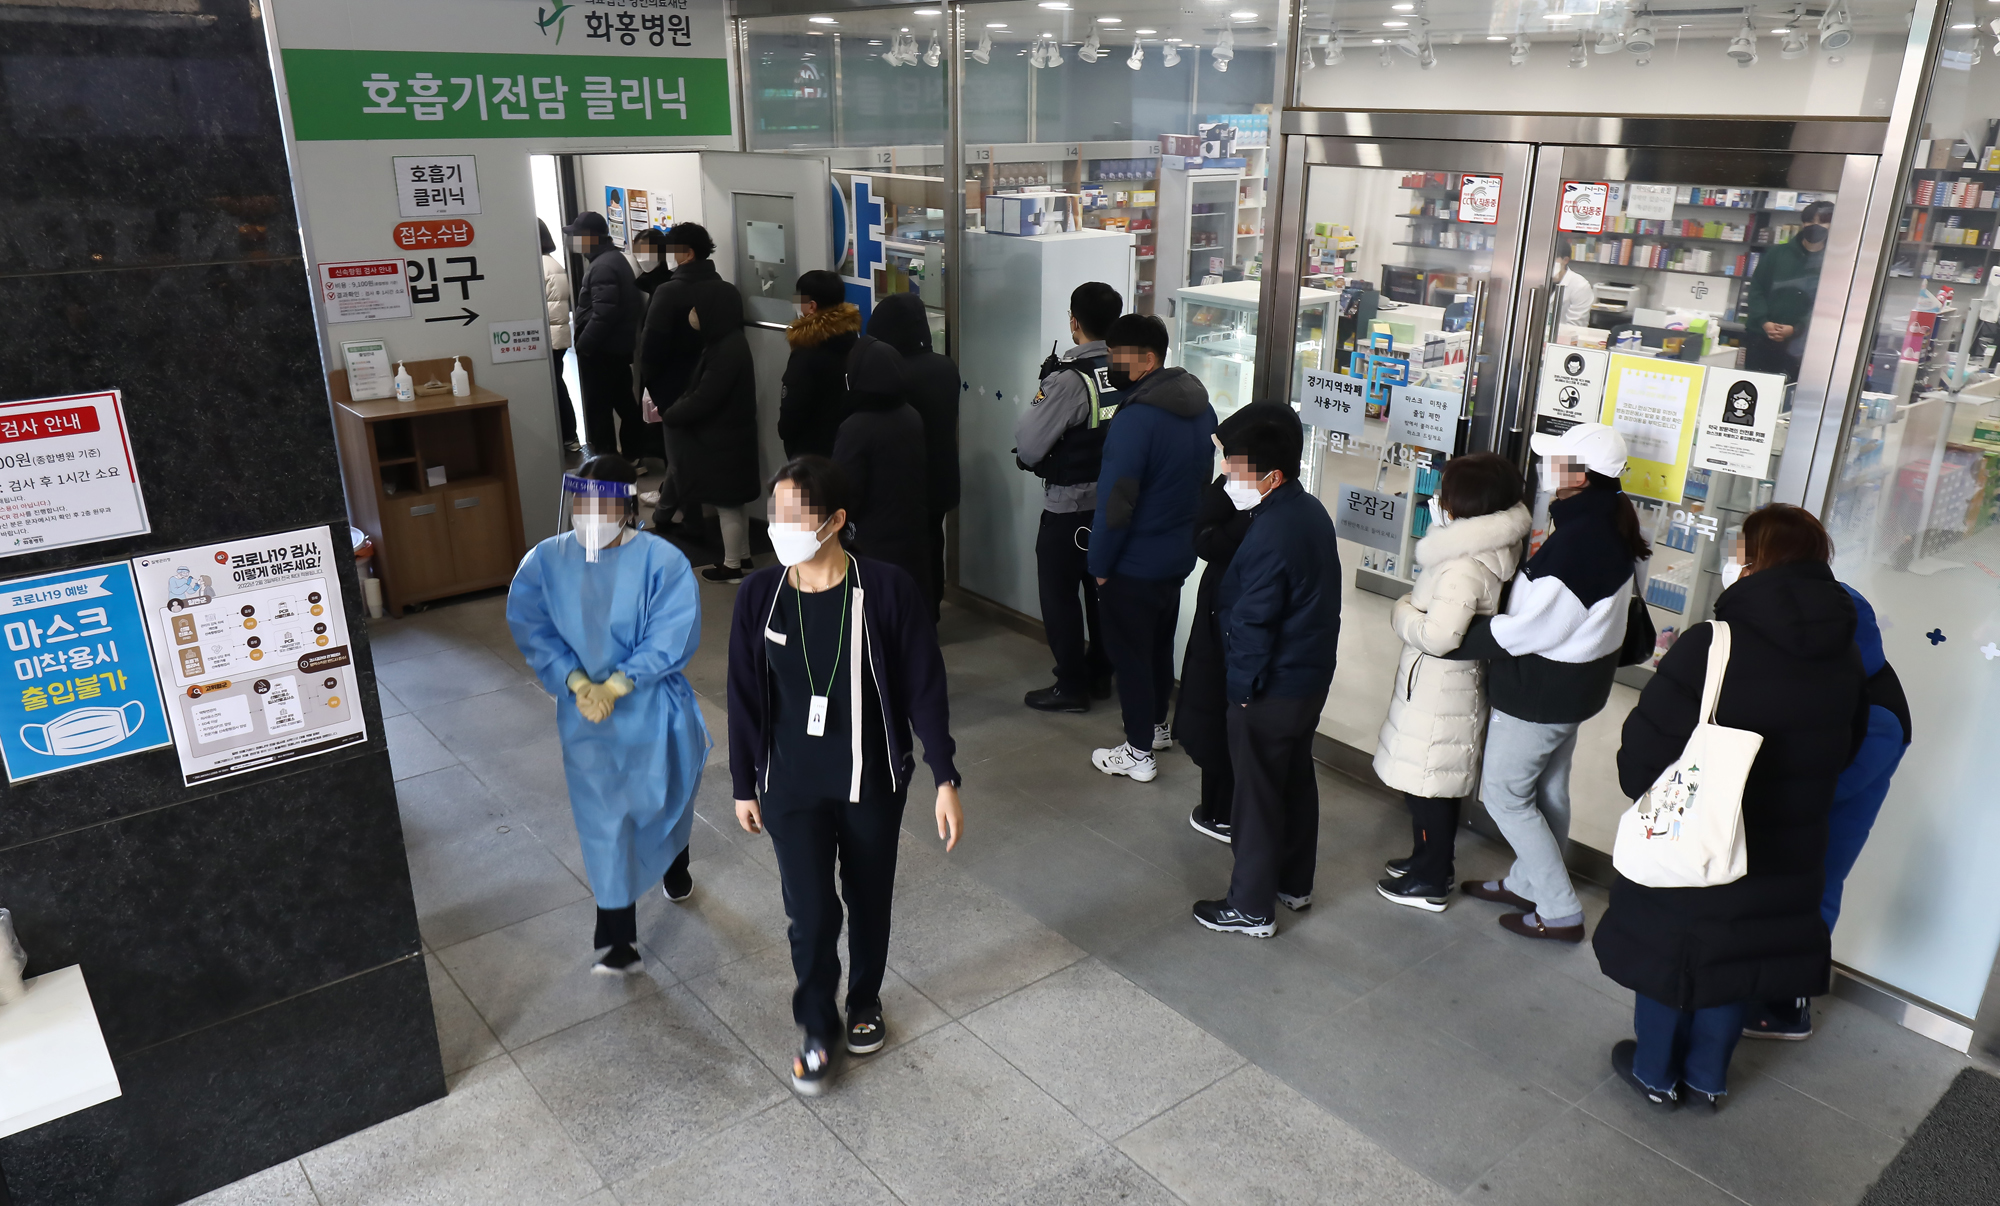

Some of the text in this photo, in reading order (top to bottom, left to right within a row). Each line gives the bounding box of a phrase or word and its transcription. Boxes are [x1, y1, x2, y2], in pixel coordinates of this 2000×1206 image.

[584, 10, 692, 47] 화홍병원
[362, 72, 687, 121] 호흡기전담 클리닉
[877, 153, 892, 163] 12
[976, 150, 990, 160] 13
[1065, 147, 1079, 157] 14
[1149, 145, 1161, 155] 15
[410, 163, 463, 184] 호흡기
[413, 186, 465, 207] 클리닉
[1462, 197, 1479, 206] CCTV
[1563, 204, 1582, 214] CCTV
[399, 223, 468, 245] 접수,수납
[335, 265, 393, 277] 신속항원 검사 안내
[407, 256, 485, 304] 입구
[1307, 375, 1363, 397] 경기지역화폐
[1314, 396, 1351, 414] 사용가능
[1405, 395, 1448, 411] 마스크 미착용
[0, 413, 82, 439] 검사 안내
[1428, 411, 1441, 422] 제한
[78, 448, 101, 460] 기준)
[8, 477, 36, 493] 검사
[40, 475, 53, 488] 후
[57, 470, 91, 485] 1시간
[95, 466, 121, 480] 소요
[13, 510, 32, 520] 검사를
[34, 505, 68, 516] 진행합니다.
[20, 499, 51, 509] 아닙니다.)
[1347, 491, 1395, 521] 문잠김
[0, 528, 29, 538] 바랍니다.
[231, 541, 321, 569] 코로나19 검사,
[232, 556, 321, 582] 이렇게 해주세요!
[11, 584, 89, 607] 코로나19 예방
[3, 606, 113, 652] 마스크
[14, 640, 119, 681] 미착용시
[21, 669, 128, 712] 출입불가
